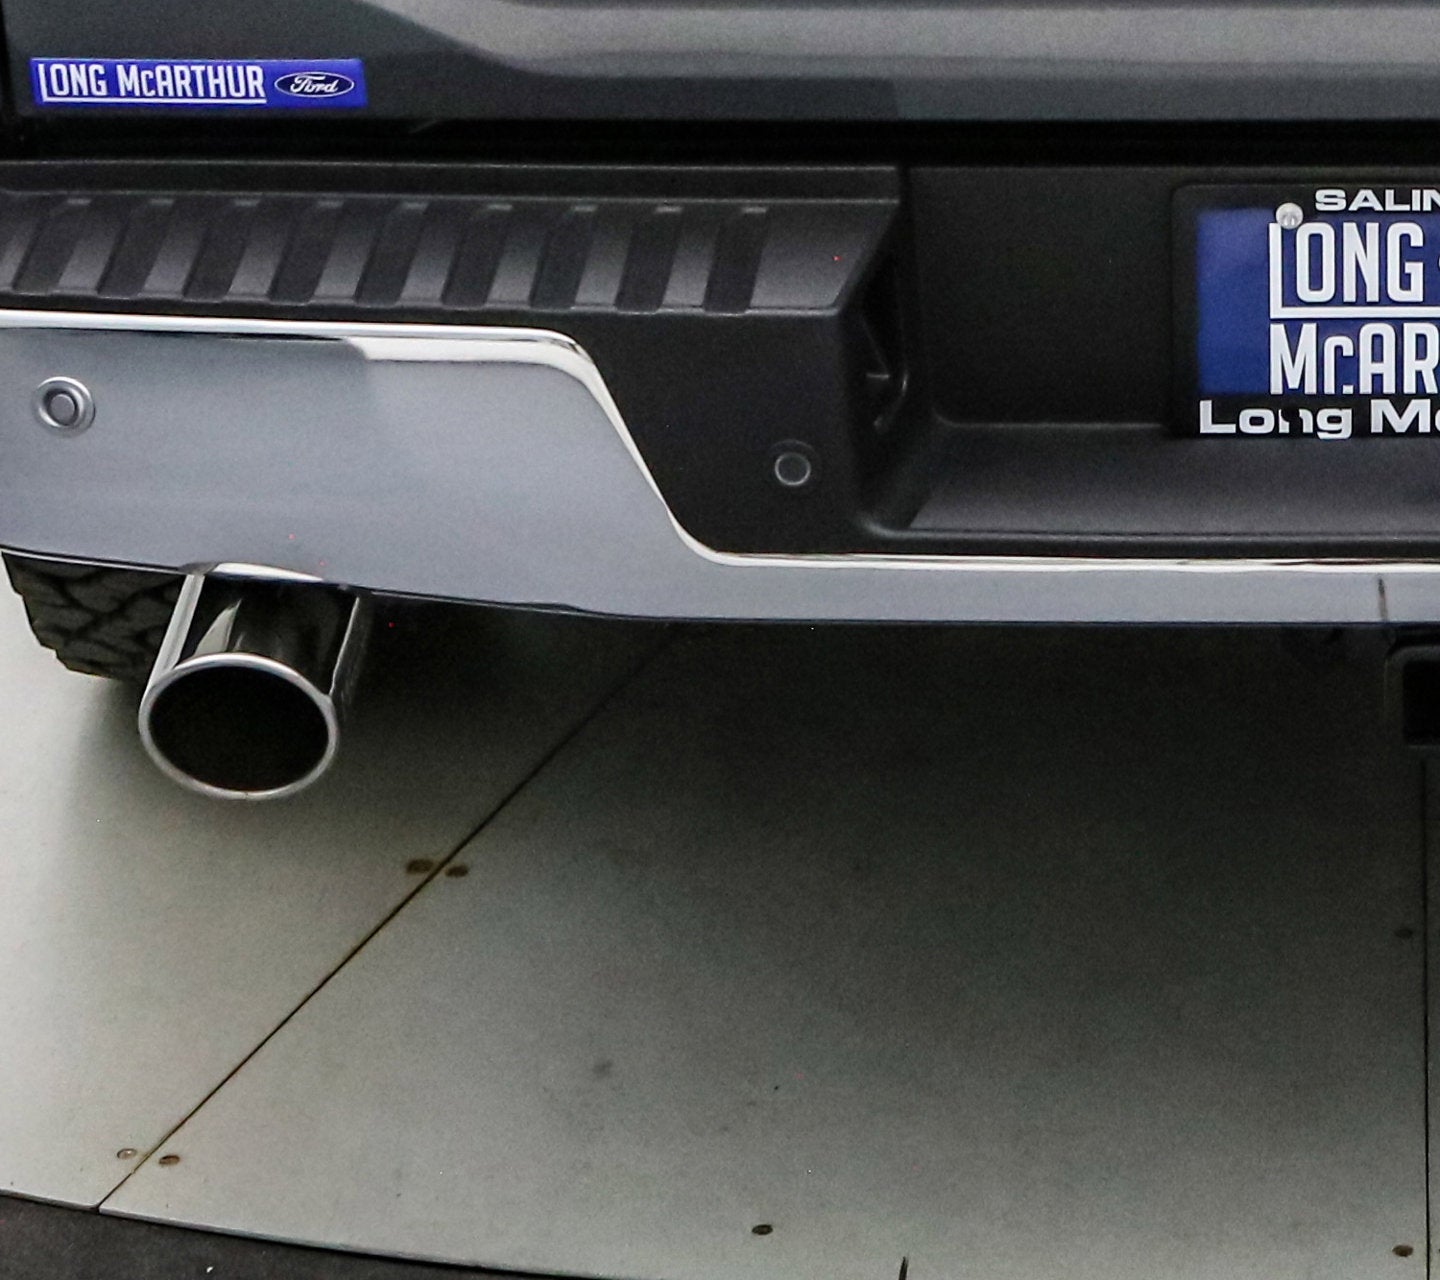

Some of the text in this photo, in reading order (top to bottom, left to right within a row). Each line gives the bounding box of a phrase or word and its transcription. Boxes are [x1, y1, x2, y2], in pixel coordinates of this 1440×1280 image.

[38, 63, 266, 103] LONG McARTHUR
[290, 75, 338, 94] Ford
[1269, 222, 1424, 318] LONG
[1199, 400, 1353, 439] Long
